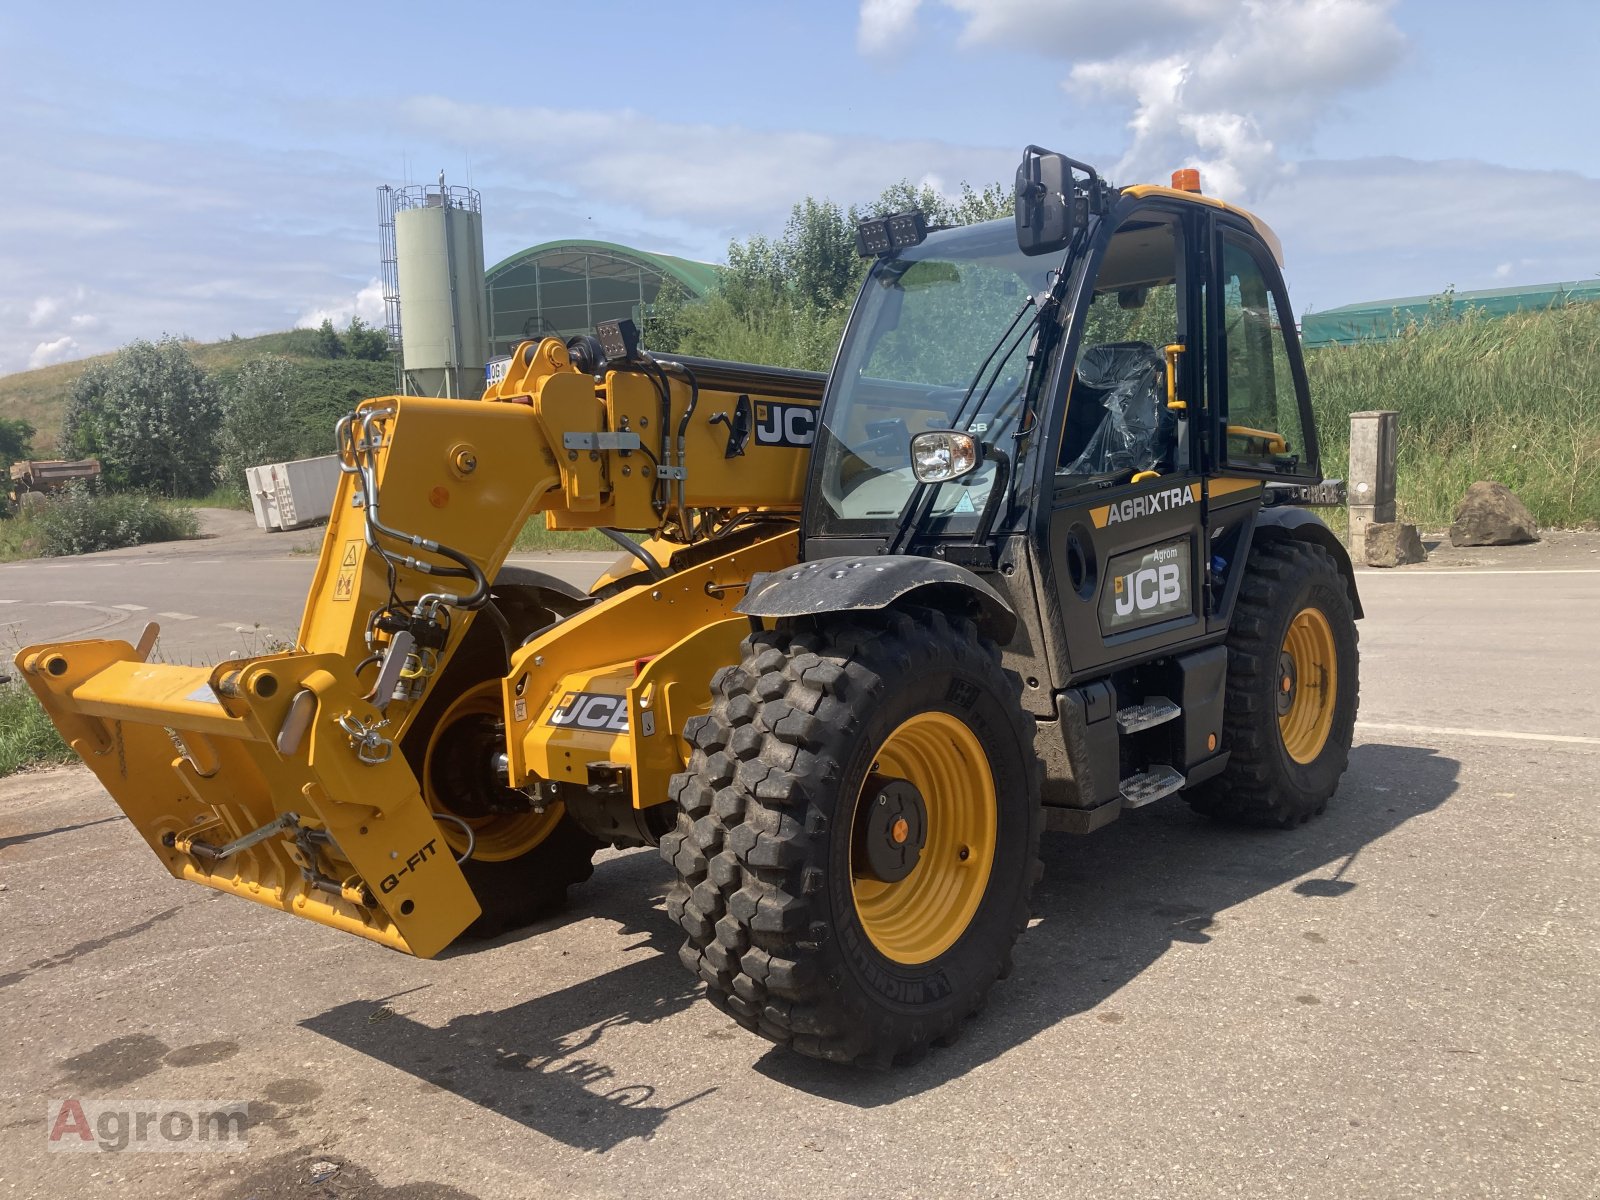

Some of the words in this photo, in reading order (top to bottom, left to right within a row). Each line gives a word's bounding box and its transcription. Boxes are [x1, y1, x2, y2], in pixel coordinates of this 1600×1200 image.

[757, 406, 819, 444] JC
[1106, 485, 1194, 526] AGRIXTRA
[1153, 549, 1178, 563] Agrom
[1115, 563, 1181, 616] JCB
[379, 838, 437, 894] Q-FIT
